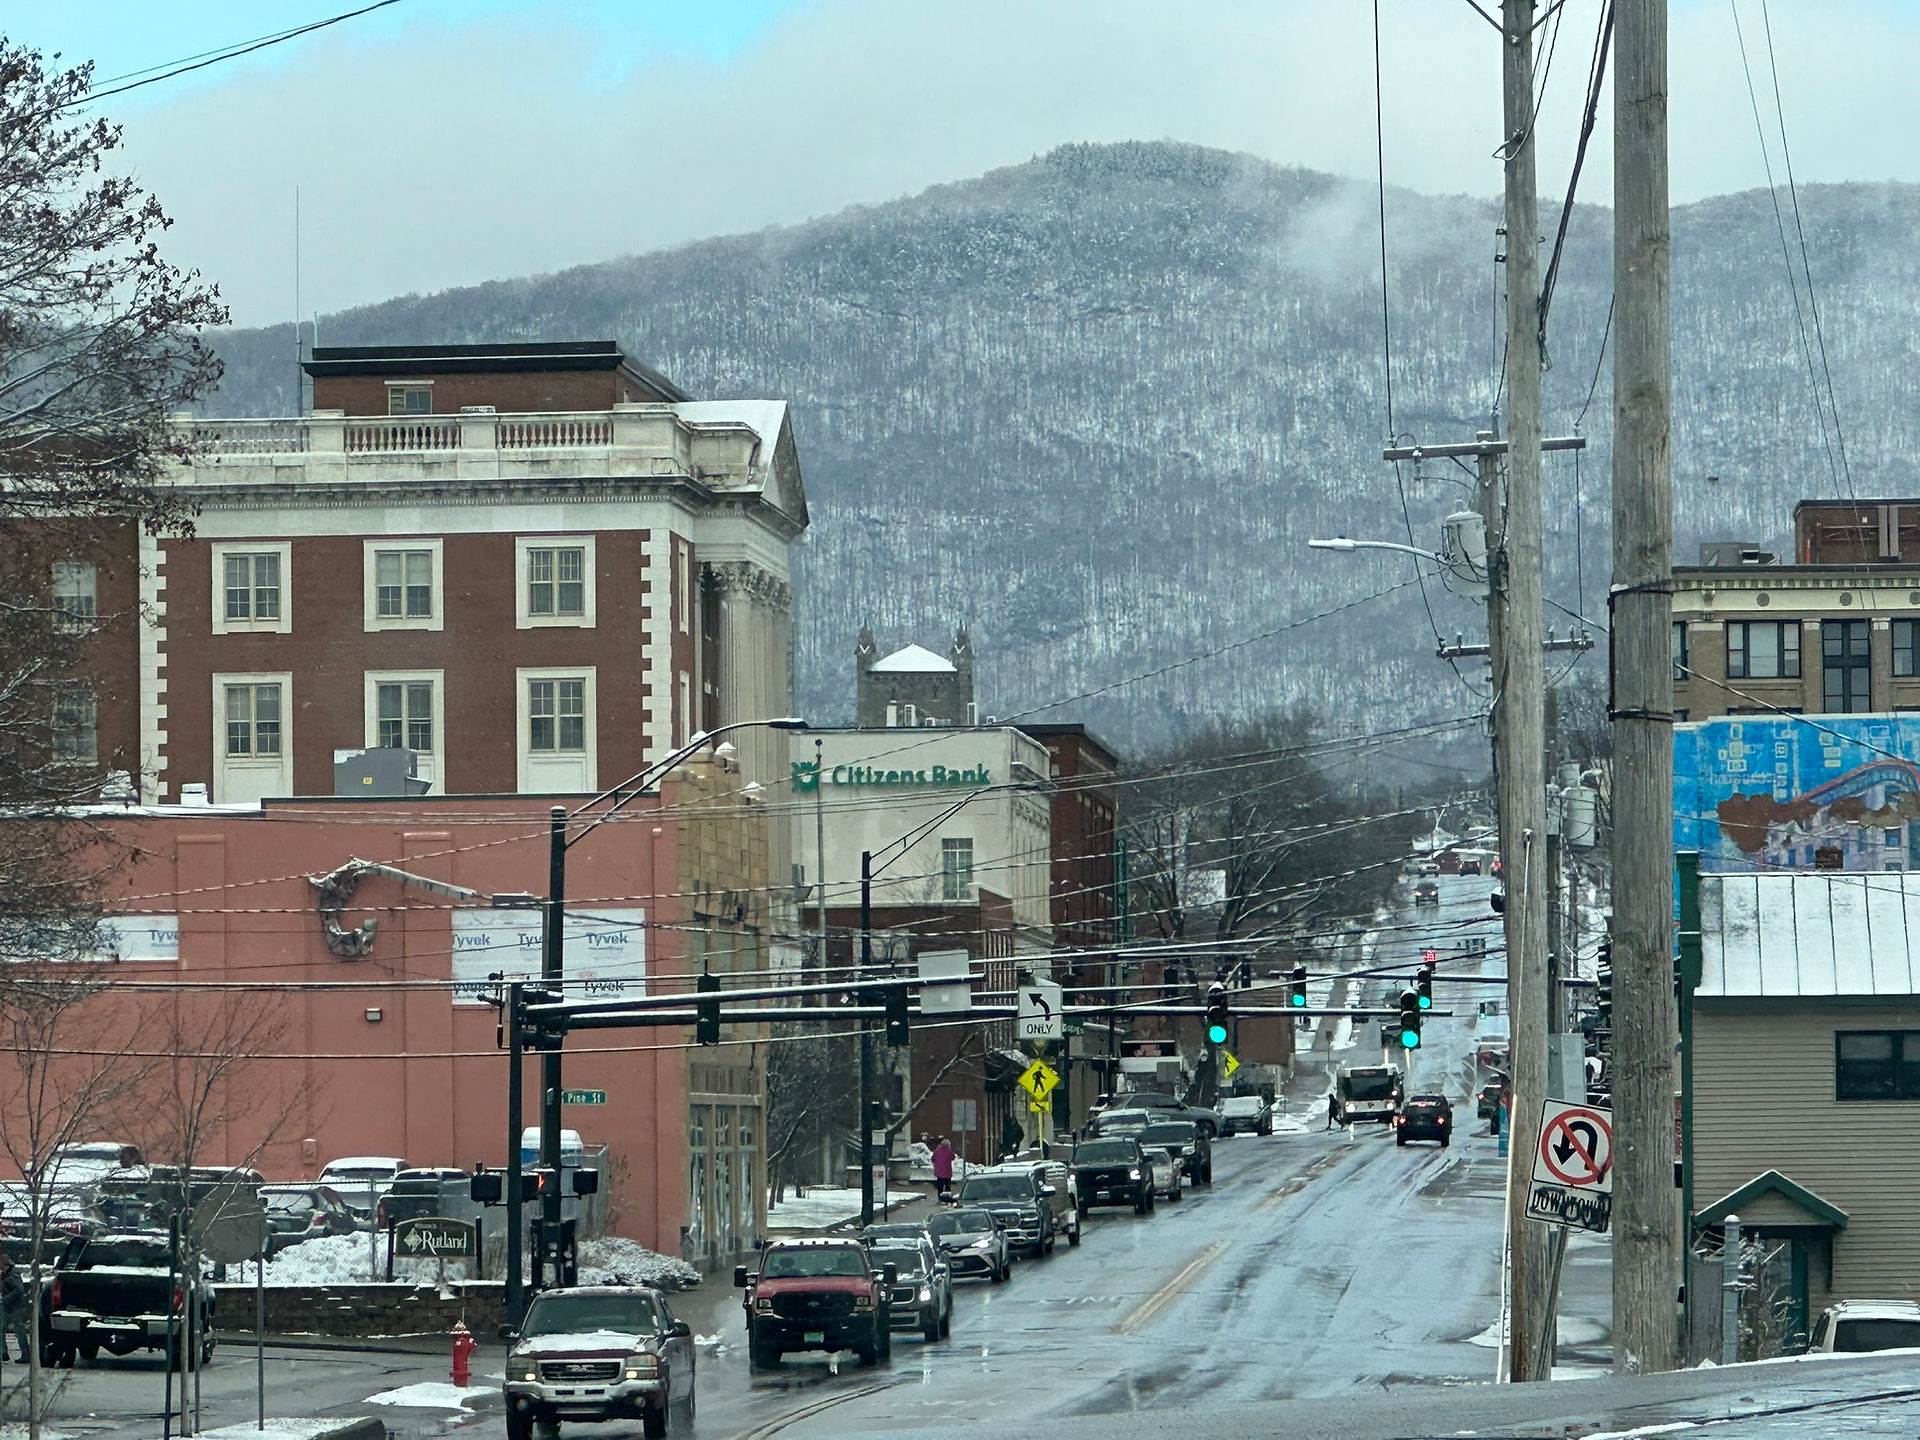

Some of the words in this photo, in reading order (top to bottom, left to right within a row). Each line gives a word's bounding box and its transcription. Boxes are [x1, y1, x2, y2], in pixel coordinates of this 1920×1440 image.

[832, 765, 926, 786] Citizens
[932, 763, 991, 785] Bank
[149, 929, 178, 942] Tyv
[453, 933, 492, 948] yvek
[517, 933, 542, 947] Tyv
[586, 931, 628, 946] Tyvek
[1026, 1023, 1053, 1034] ONLY
[421, 1230, 467, 1255] Rutland
